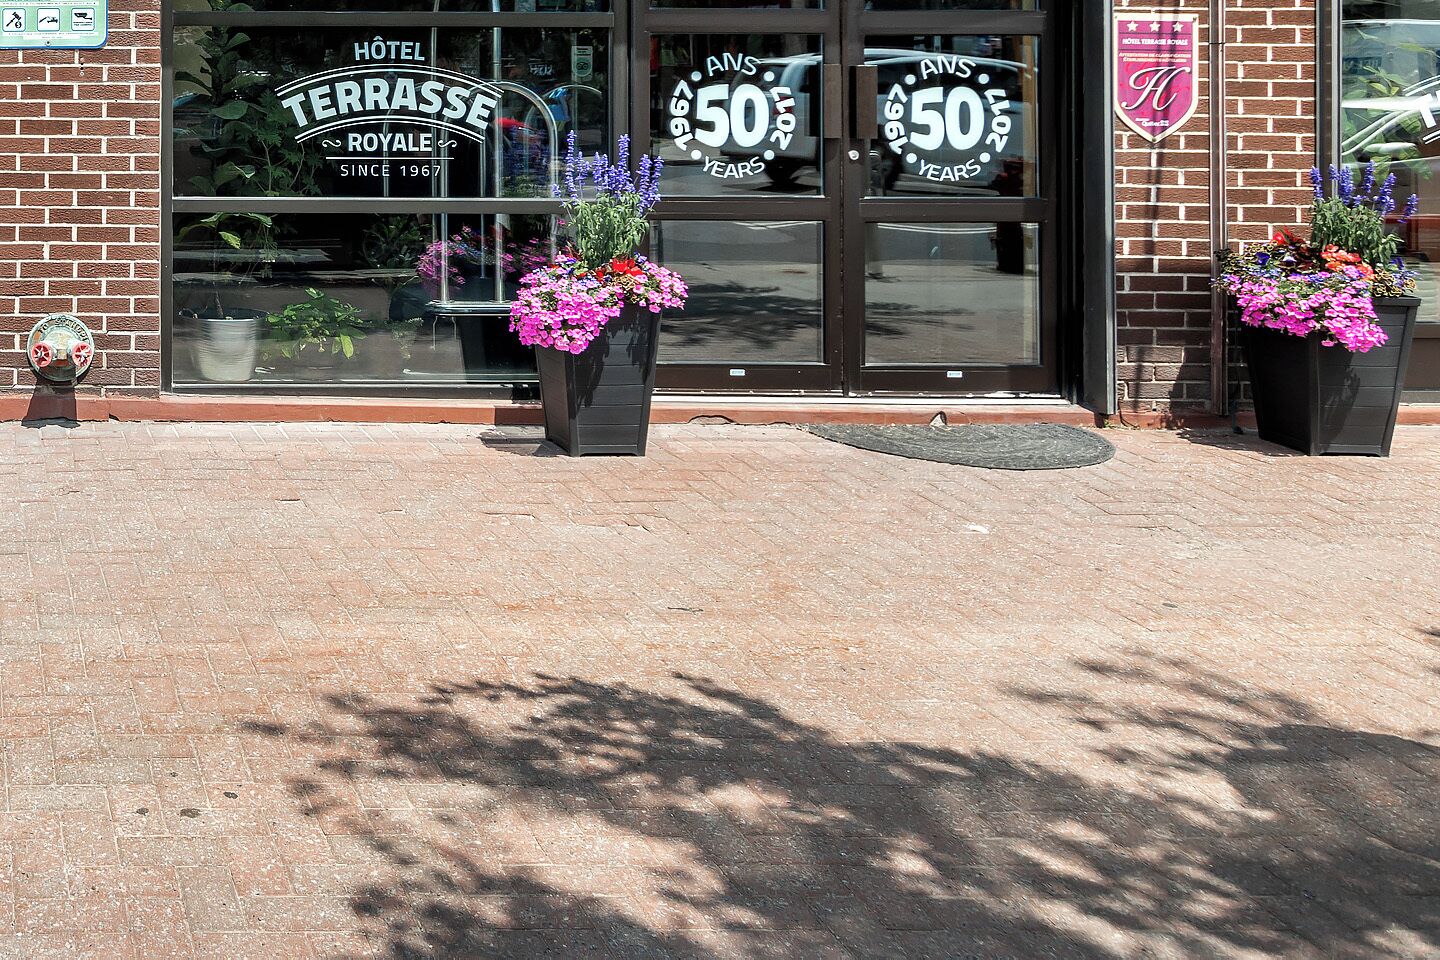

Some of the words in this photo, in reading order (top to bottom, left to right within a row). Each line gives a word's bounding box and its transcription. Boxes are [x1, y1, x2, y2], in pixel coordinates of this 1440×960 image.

[354, 36, 425, 61] HÔTEL
[705, 52, 760, 76] ANS
[920, 55, 976, 80] ANS
[281, 78, 497, 130] TERRASSE
[670, 79, 694, 151] 1967
[694, 83, 770, 148] 50
[769, 86, 796, 151] 2017
[884, 83, 909, 155] 1967
[910, 86, 985, 151] 50
[984, 88, 1012, 153] 2017
[347, 132, 433, 152] ROYALE
[340, 164, 390, 177] SINCE
[400, 165, 441, 177] 1967
[702, 156, 765, 179] YEARS
[918, 158, 982, 182] YEARS
